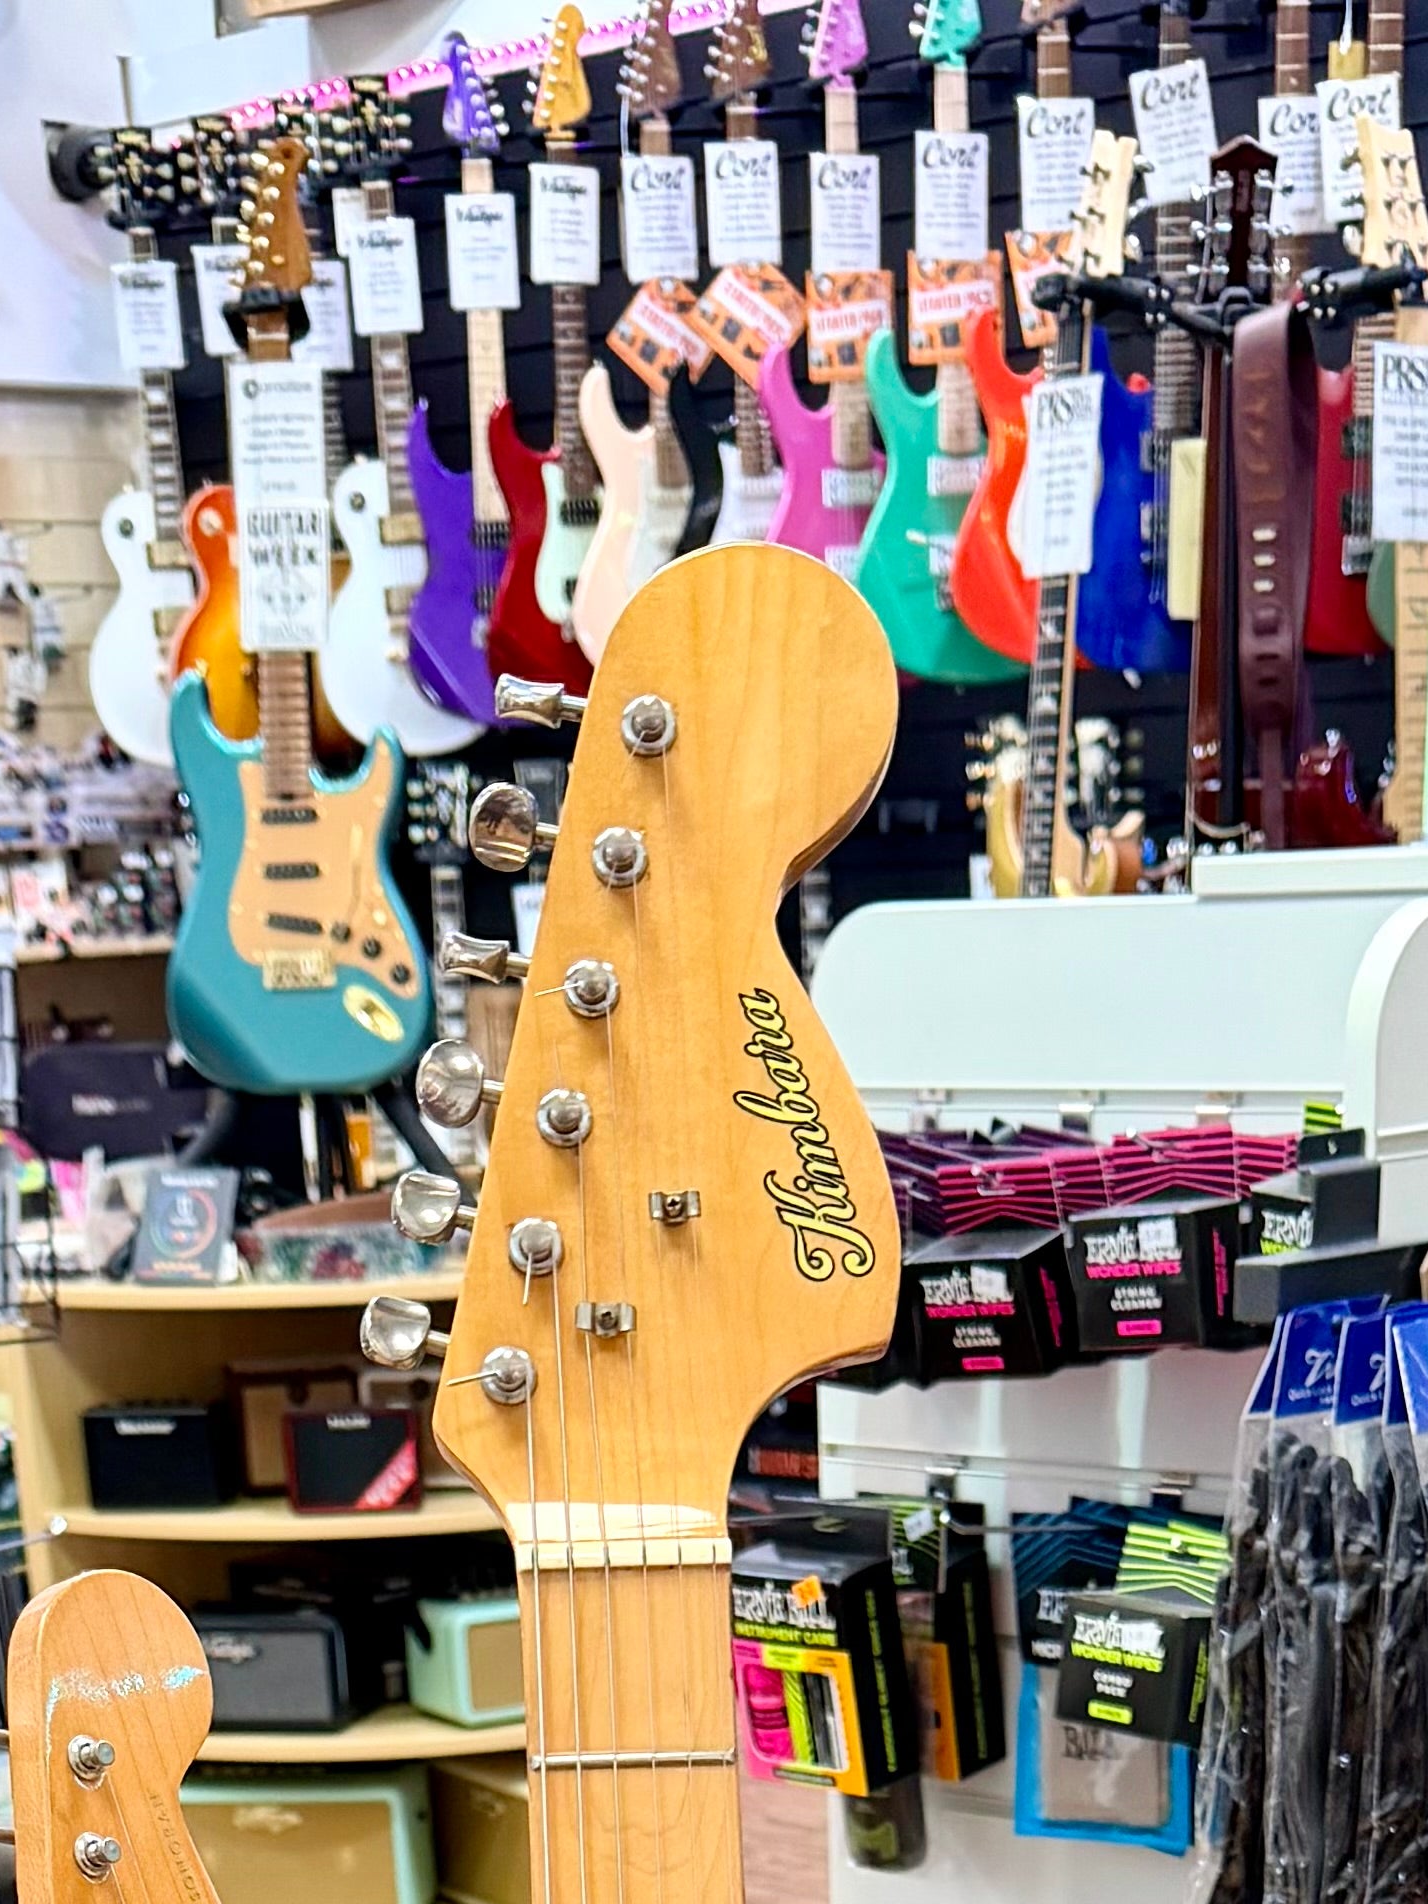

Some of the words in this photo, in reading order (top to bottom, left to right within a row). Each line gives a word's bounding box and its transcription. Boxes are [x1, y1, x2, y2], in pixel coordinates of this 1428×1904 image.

[1141, 73, 1200, 110] Cort
[1327, 87, 1392, 123] Cort
[1027, 108, 1085, 138] Cort
[1272, 104, 1320, 136] Cor
[716, 149, 772, 181] Cort
[923, 139, 980, 169] Cort
[819, 160, 873, 191] Cort
[1382, 353, 1428, 394] PRS
[732, 986, 876, 1283] Kimbara
[1083, 1223, 1138, 1264] ERNIE
[920, 1266, 971, 1305] ERNIE
[1085, 1264, 1140, 1280] WONDER
[1142, 1261, 1182, 1277] WIPES
[925, 1303, 976, 1319] WONDER
[976, 1300, 1016, 1316] WIPES
[1110, 1298, 1163, 1312] CLEANER
[732, 1580, 787, 1624] ERNIE
[802, 1630, 838, 1646] CARE
[1071, 1641, 1123, 1665] WONDER
[1123, 1652, 1164, 1673] WIPES
